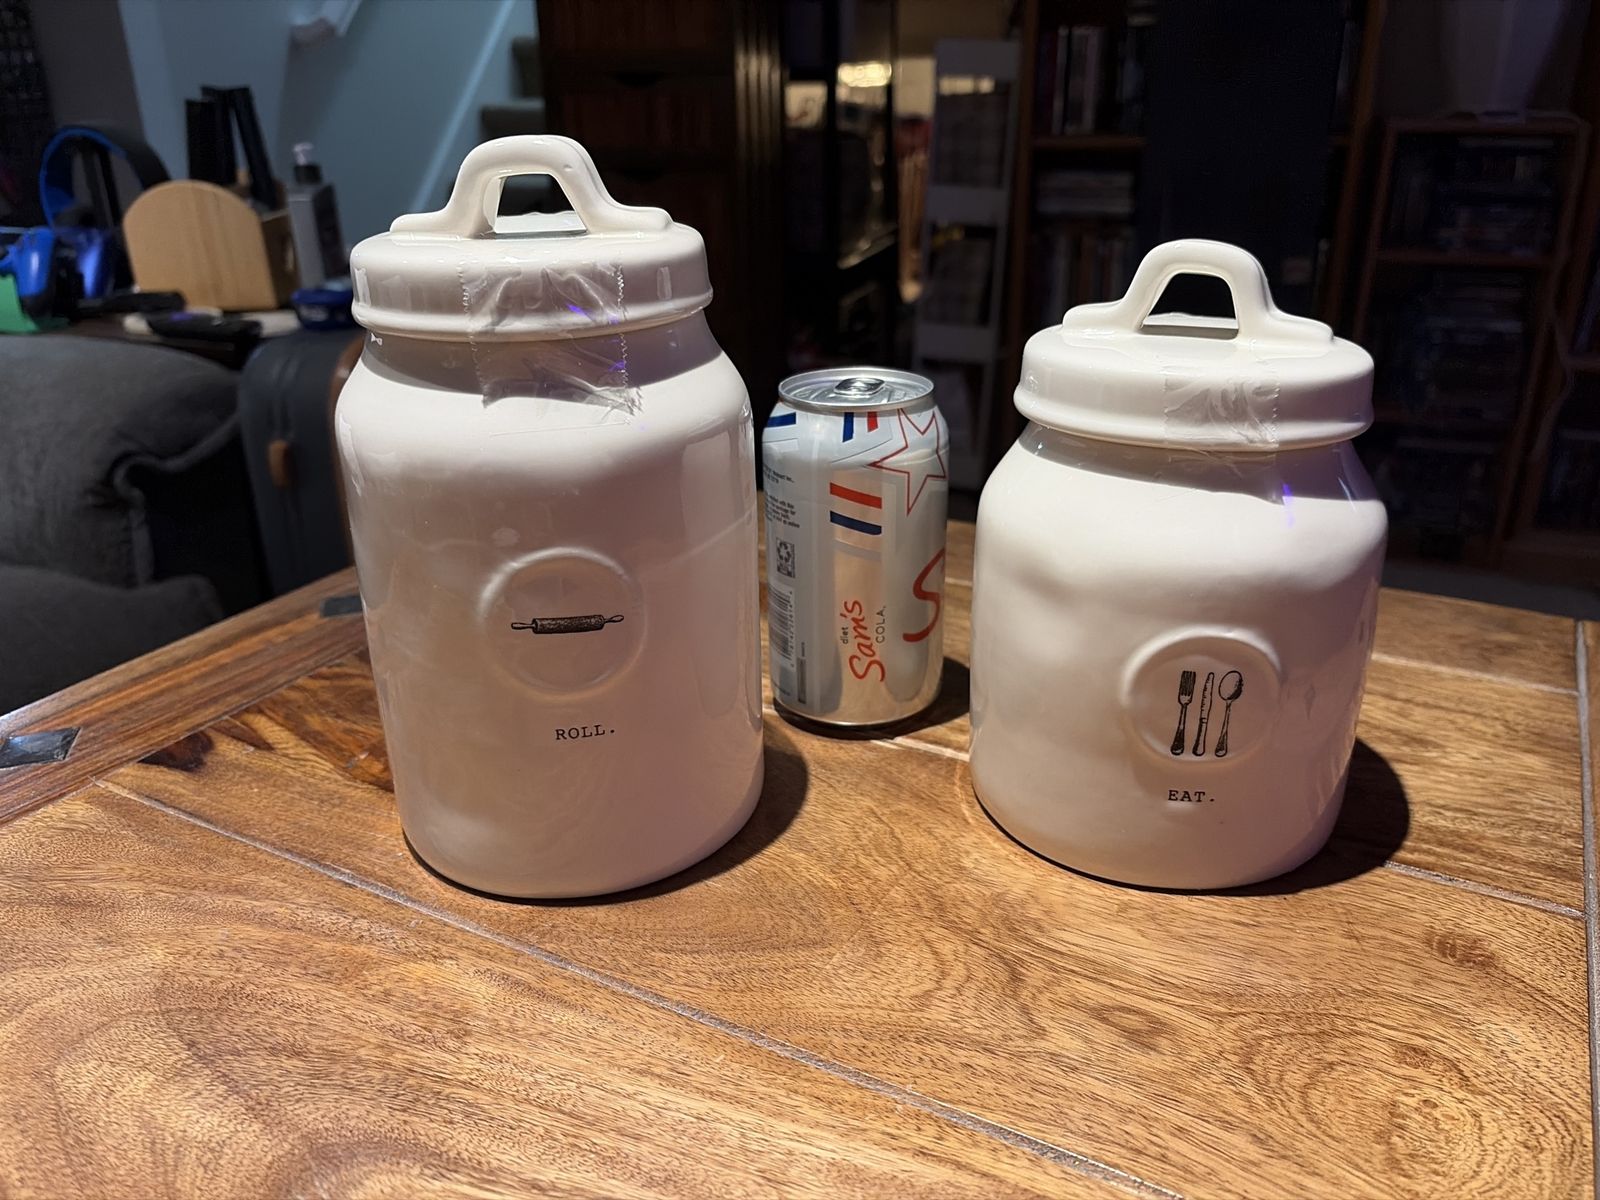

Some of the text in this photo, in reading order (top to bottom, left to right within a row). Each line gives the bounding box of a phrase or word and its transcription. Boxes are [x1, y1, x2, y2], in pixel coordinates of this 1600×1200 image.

[840, 626, 849, 645] diet
[840, 600, 886, 682] Sam's
[555, 724, 615, 740] ROLL.
[1168, 789, 1215, 802] EAT.
